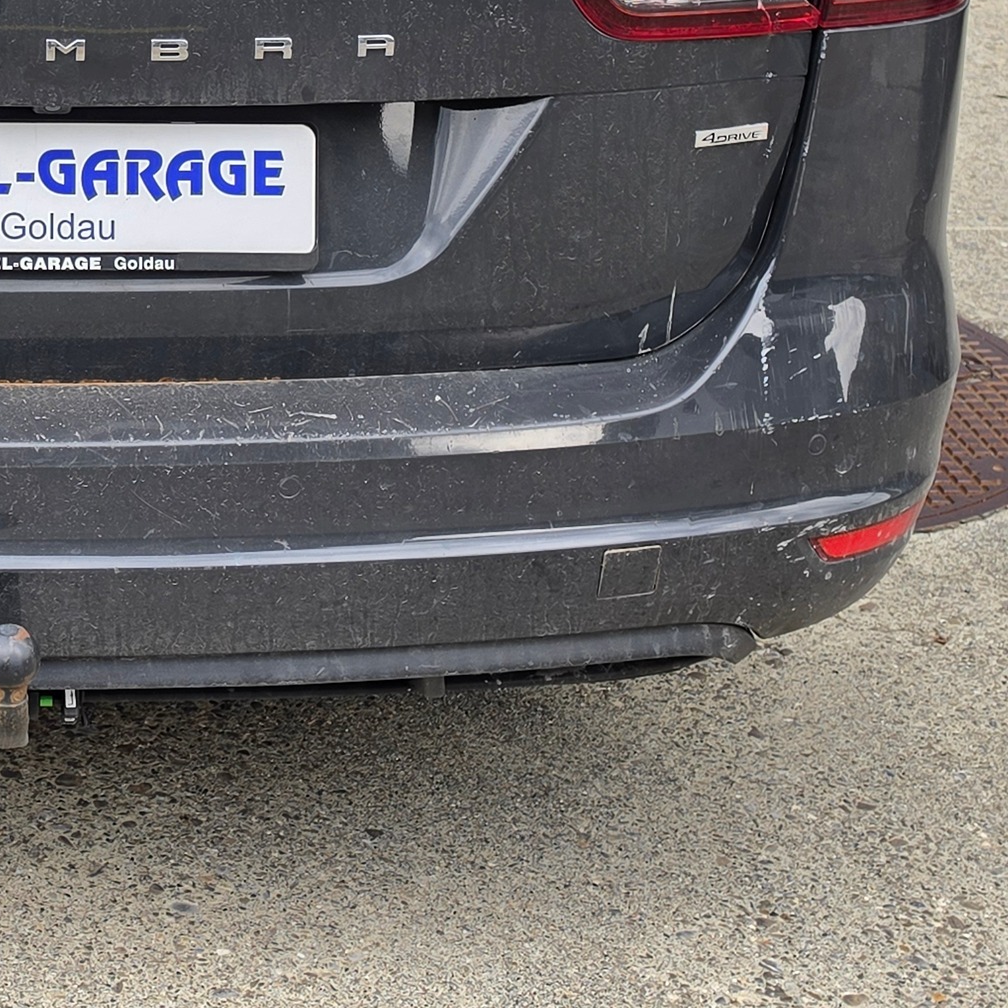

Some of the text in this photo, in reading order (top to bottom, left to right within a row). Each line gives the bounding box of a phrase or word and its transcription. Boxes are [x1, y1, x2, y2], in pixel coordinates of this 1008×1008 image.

[701, 130, 762, 144] 4DRIVE
[1, 211, 115, 240] Goldau
[113, 255, 176, 271] Goldau
